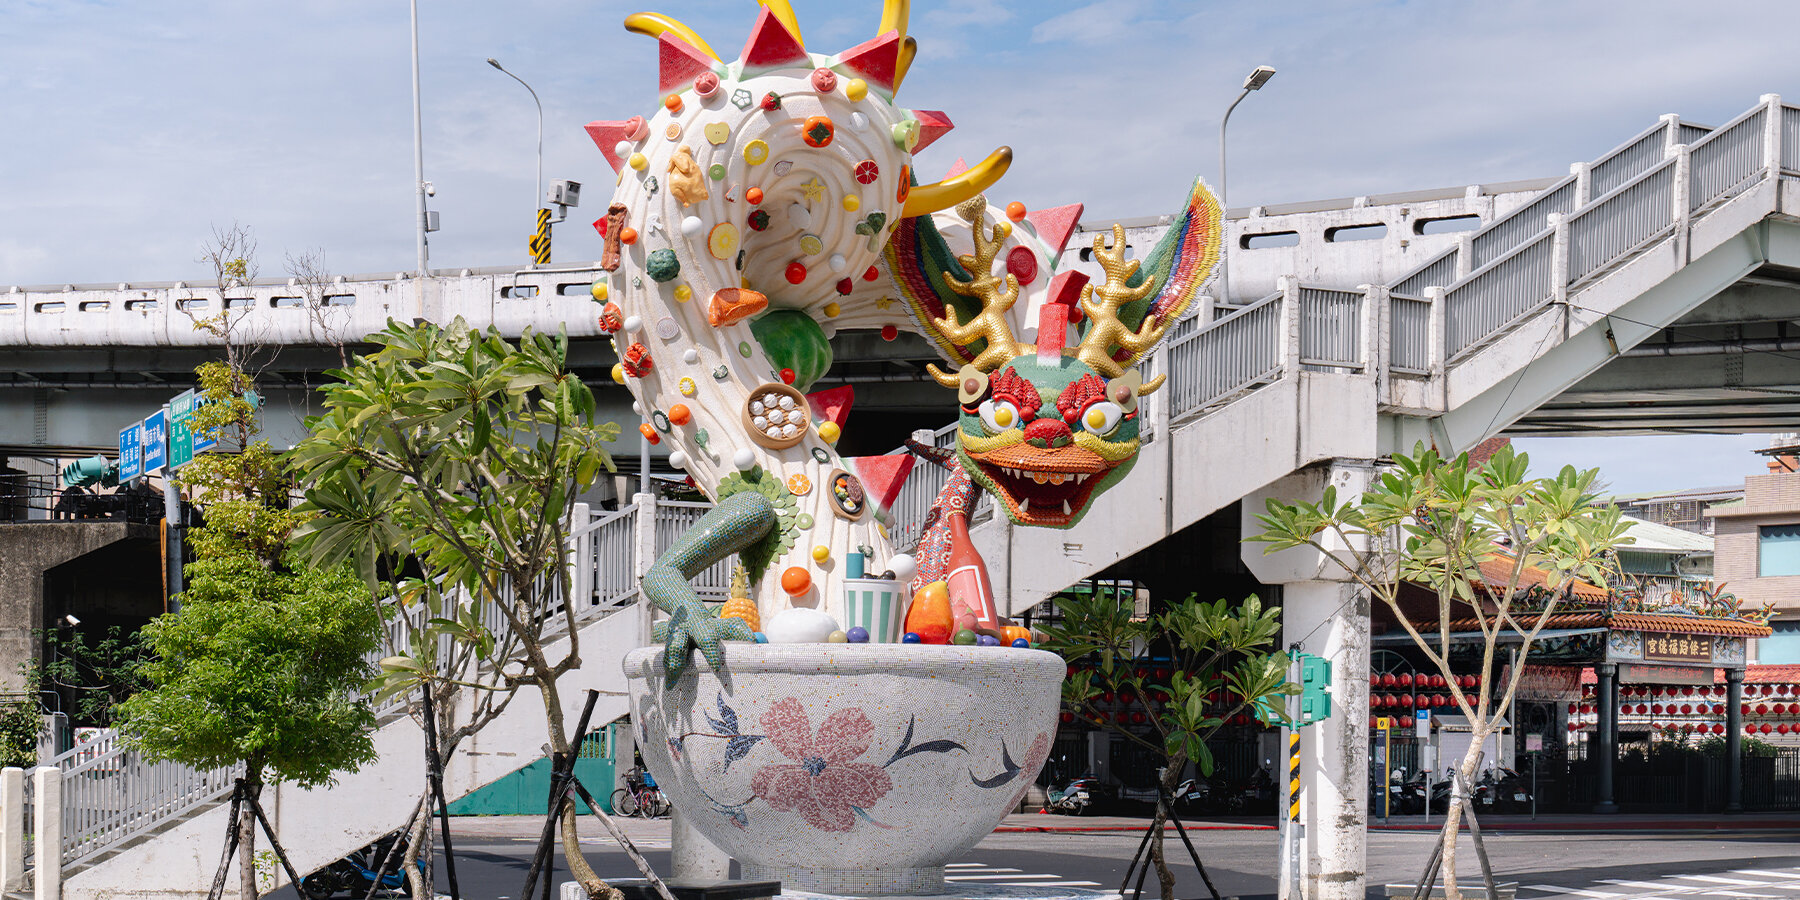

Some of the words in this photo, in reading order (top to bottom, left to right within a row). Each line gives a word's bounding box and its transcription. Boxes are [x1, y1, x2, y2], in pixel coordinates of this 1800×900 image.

[1647, 638, 1709, 656] 三條路福德宮
